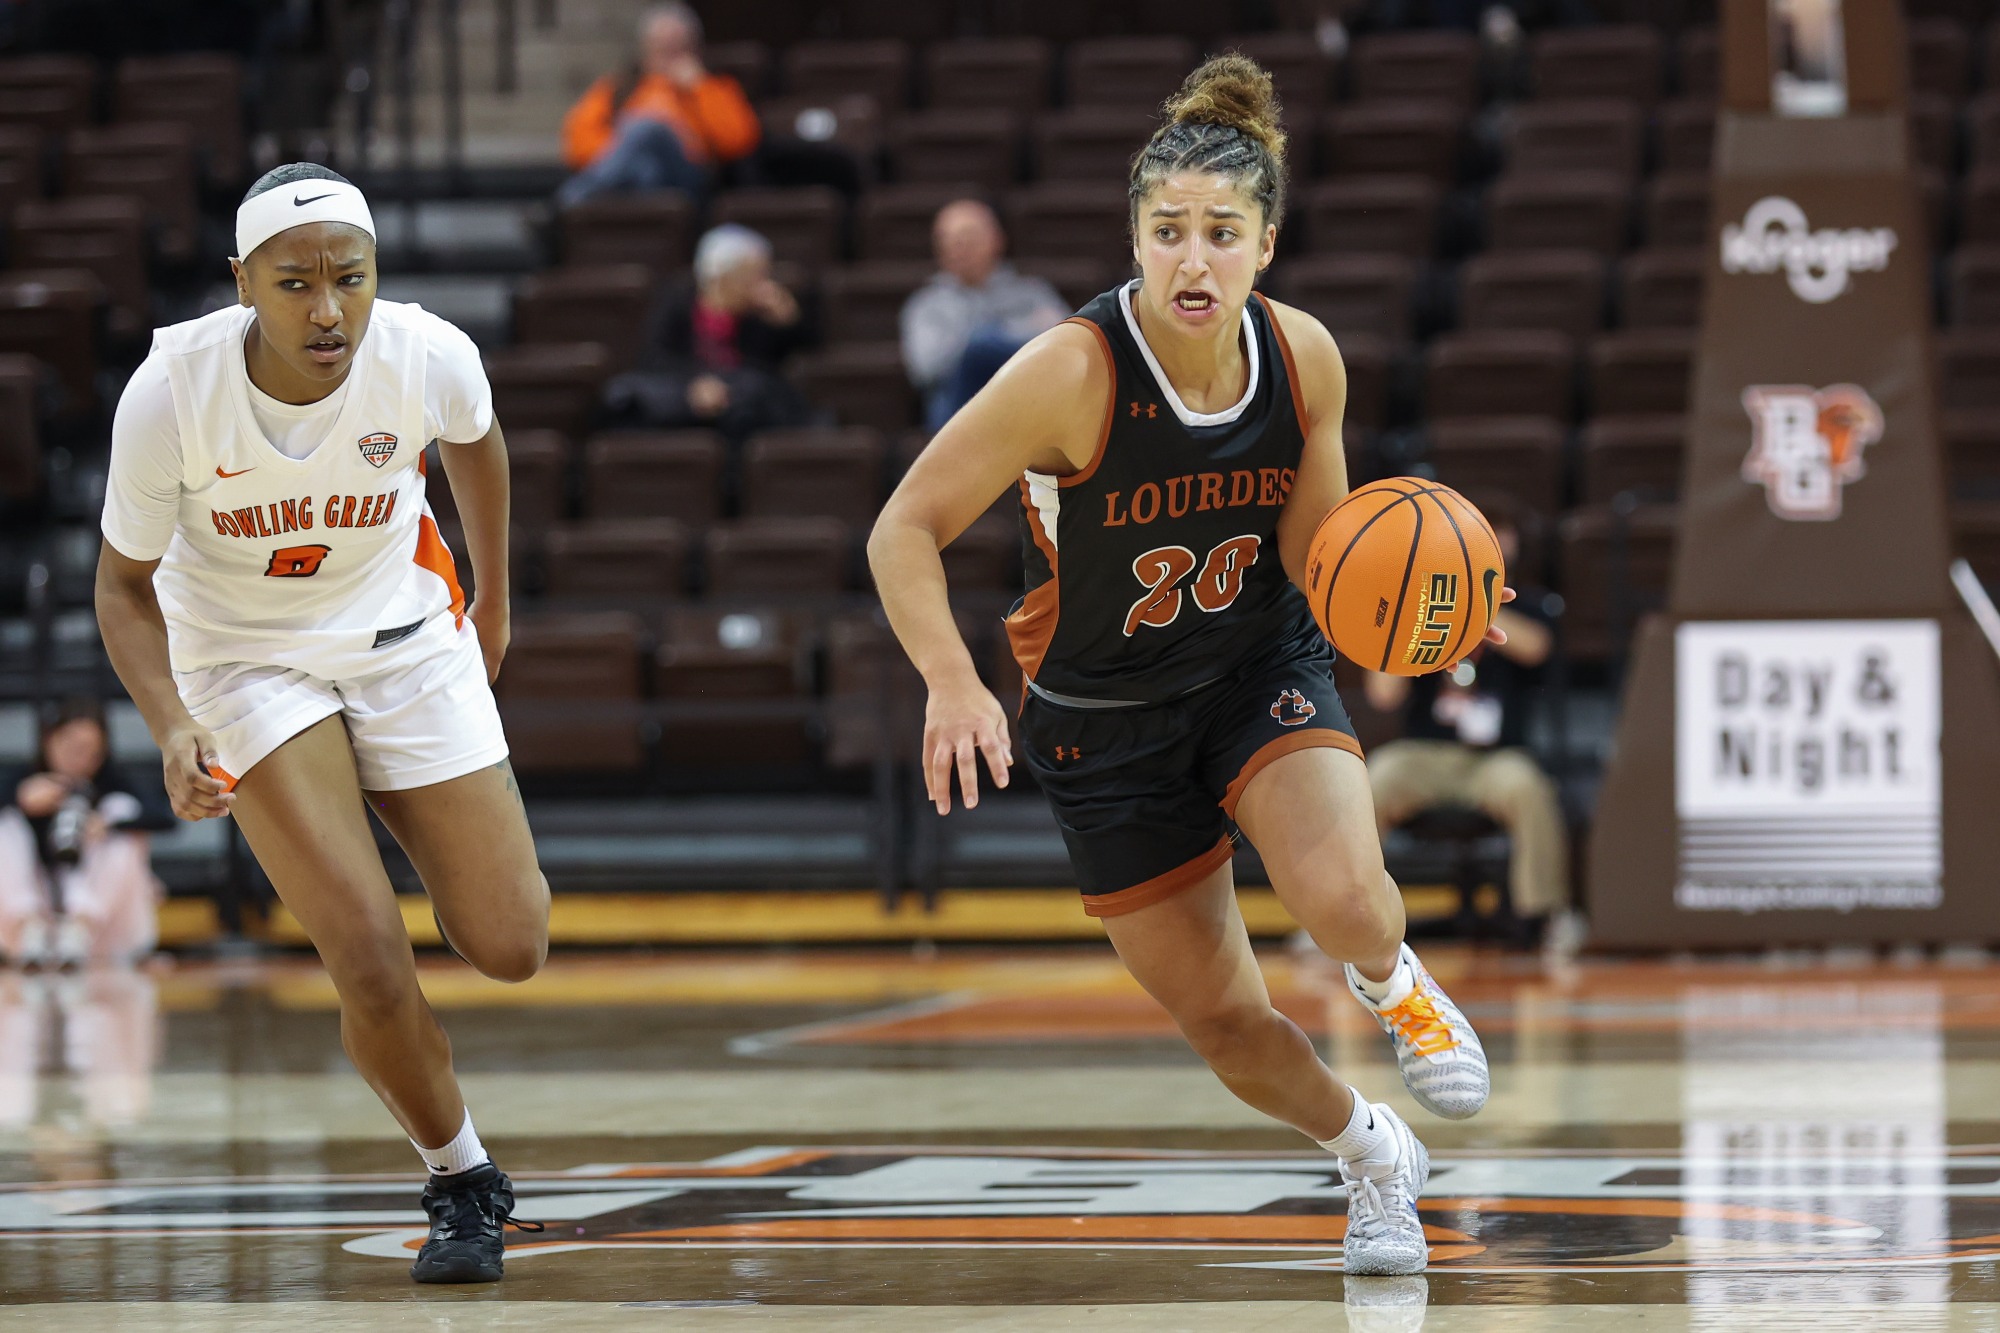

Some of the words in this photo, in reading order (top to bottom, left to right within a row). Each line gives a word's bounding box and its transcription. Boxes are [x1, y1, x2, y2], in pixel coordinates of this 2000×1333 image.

[361, 443, 396, 455] MAC
[324, 489, 399, 528] GREEN
[1103, 467, 1297, 527] LOURDES
[1122, 534, 1262, 637] 20
[1402, 571, 1429, 664] CHAMPIONSHIP
[1410, 573, 1458, 665] ELITE
[1716, 652, 1832, 718] Day
[1857, 649, 1897, 707] &
[1715, 726, 1902, 792] Night
